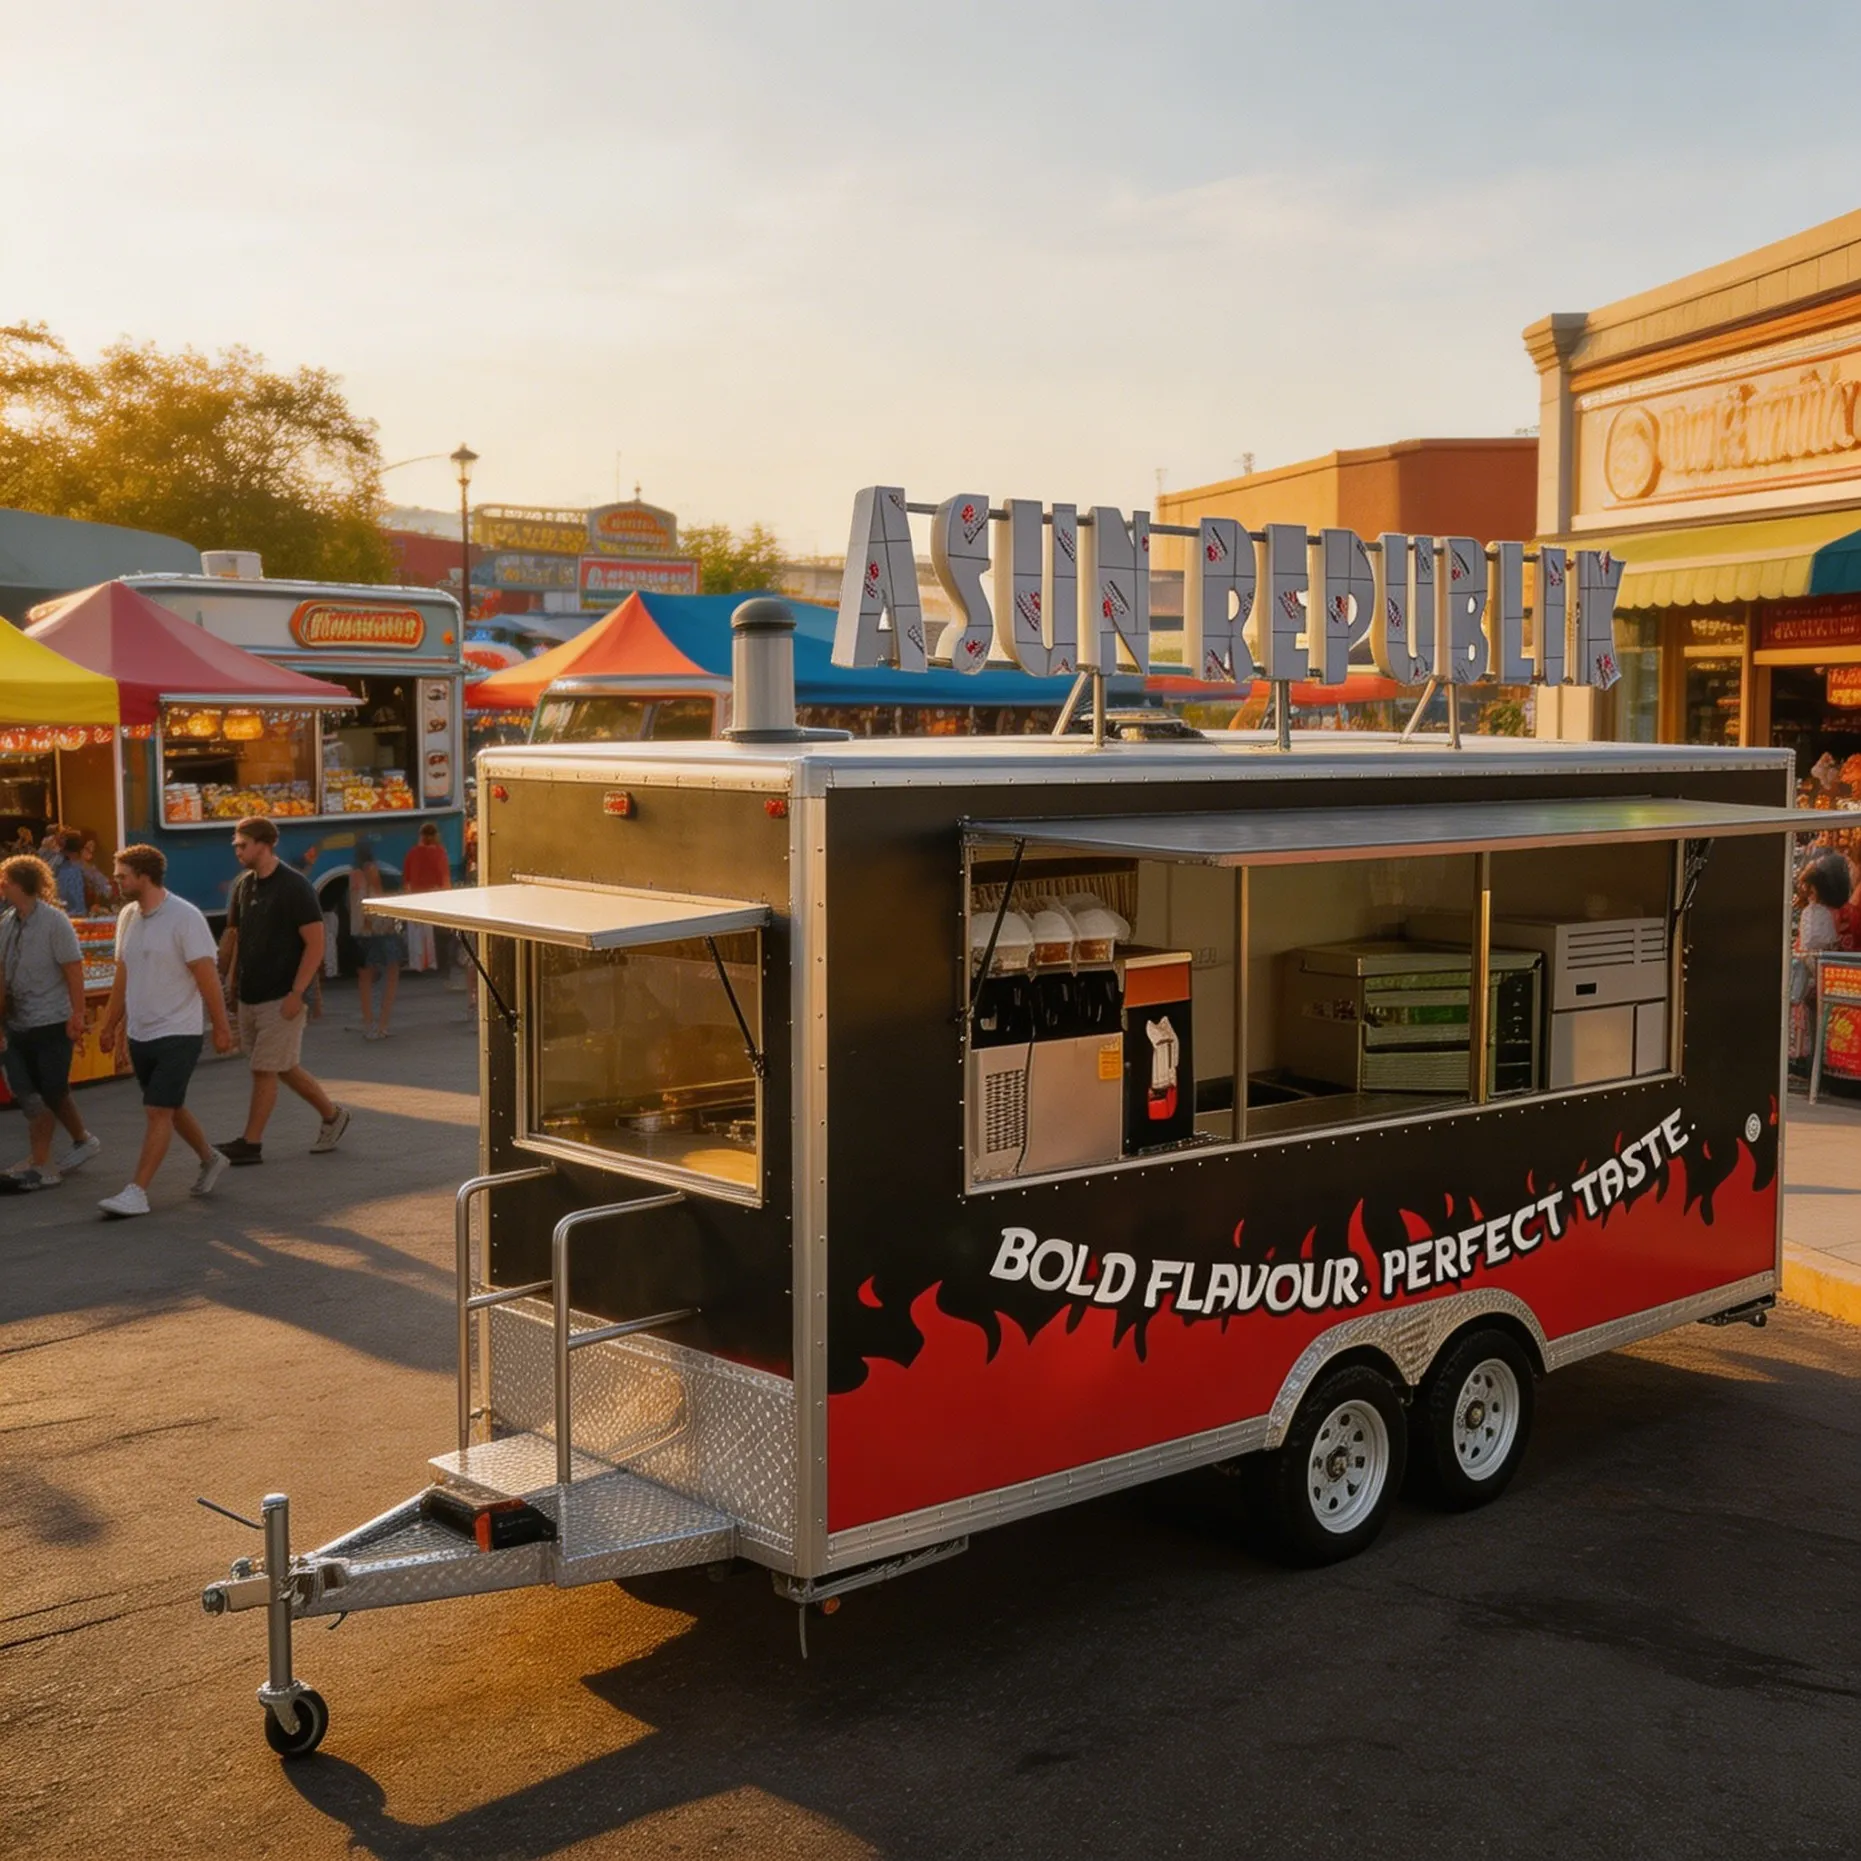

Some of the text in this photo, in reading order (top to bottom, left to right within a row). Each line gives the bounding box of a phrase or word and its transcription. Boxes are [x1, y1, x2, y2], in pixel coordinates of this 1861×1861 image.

[831, 486, 1150, 676] ASUN
[990, 1108, 1697, 1314] BOLD FLAVOUR. PERFECT TASTE.
